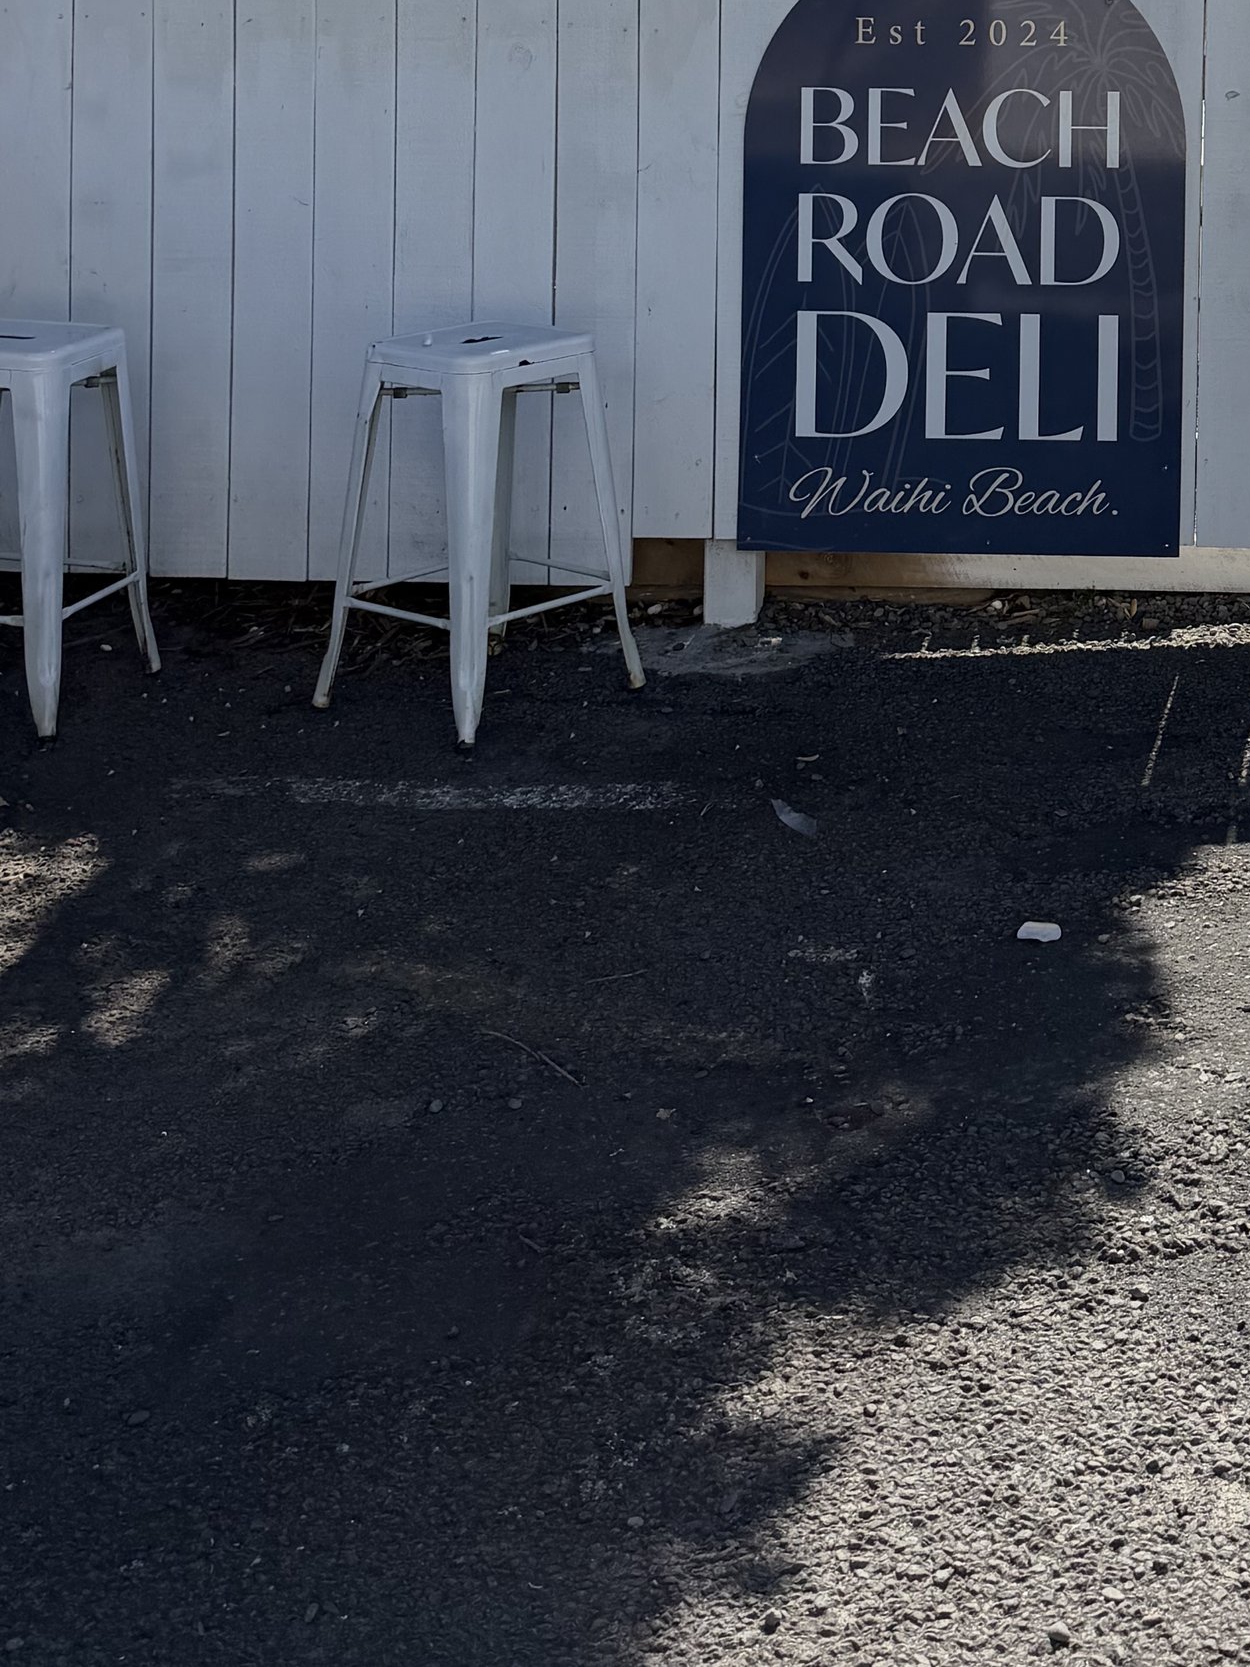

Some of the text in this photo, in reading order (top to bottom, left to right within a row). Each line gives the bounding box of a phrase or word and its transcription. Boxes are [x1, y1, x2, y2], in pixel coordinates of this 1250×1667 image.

[854, 17, 1069, 47] Est 2024
[799, 86, 1121, 170] BEACH
[796, 192, 1121, 287] ROAD
[794, 310, 1119, 443] DELI
[788, 466, 1119, 519] Waihi Beach.
